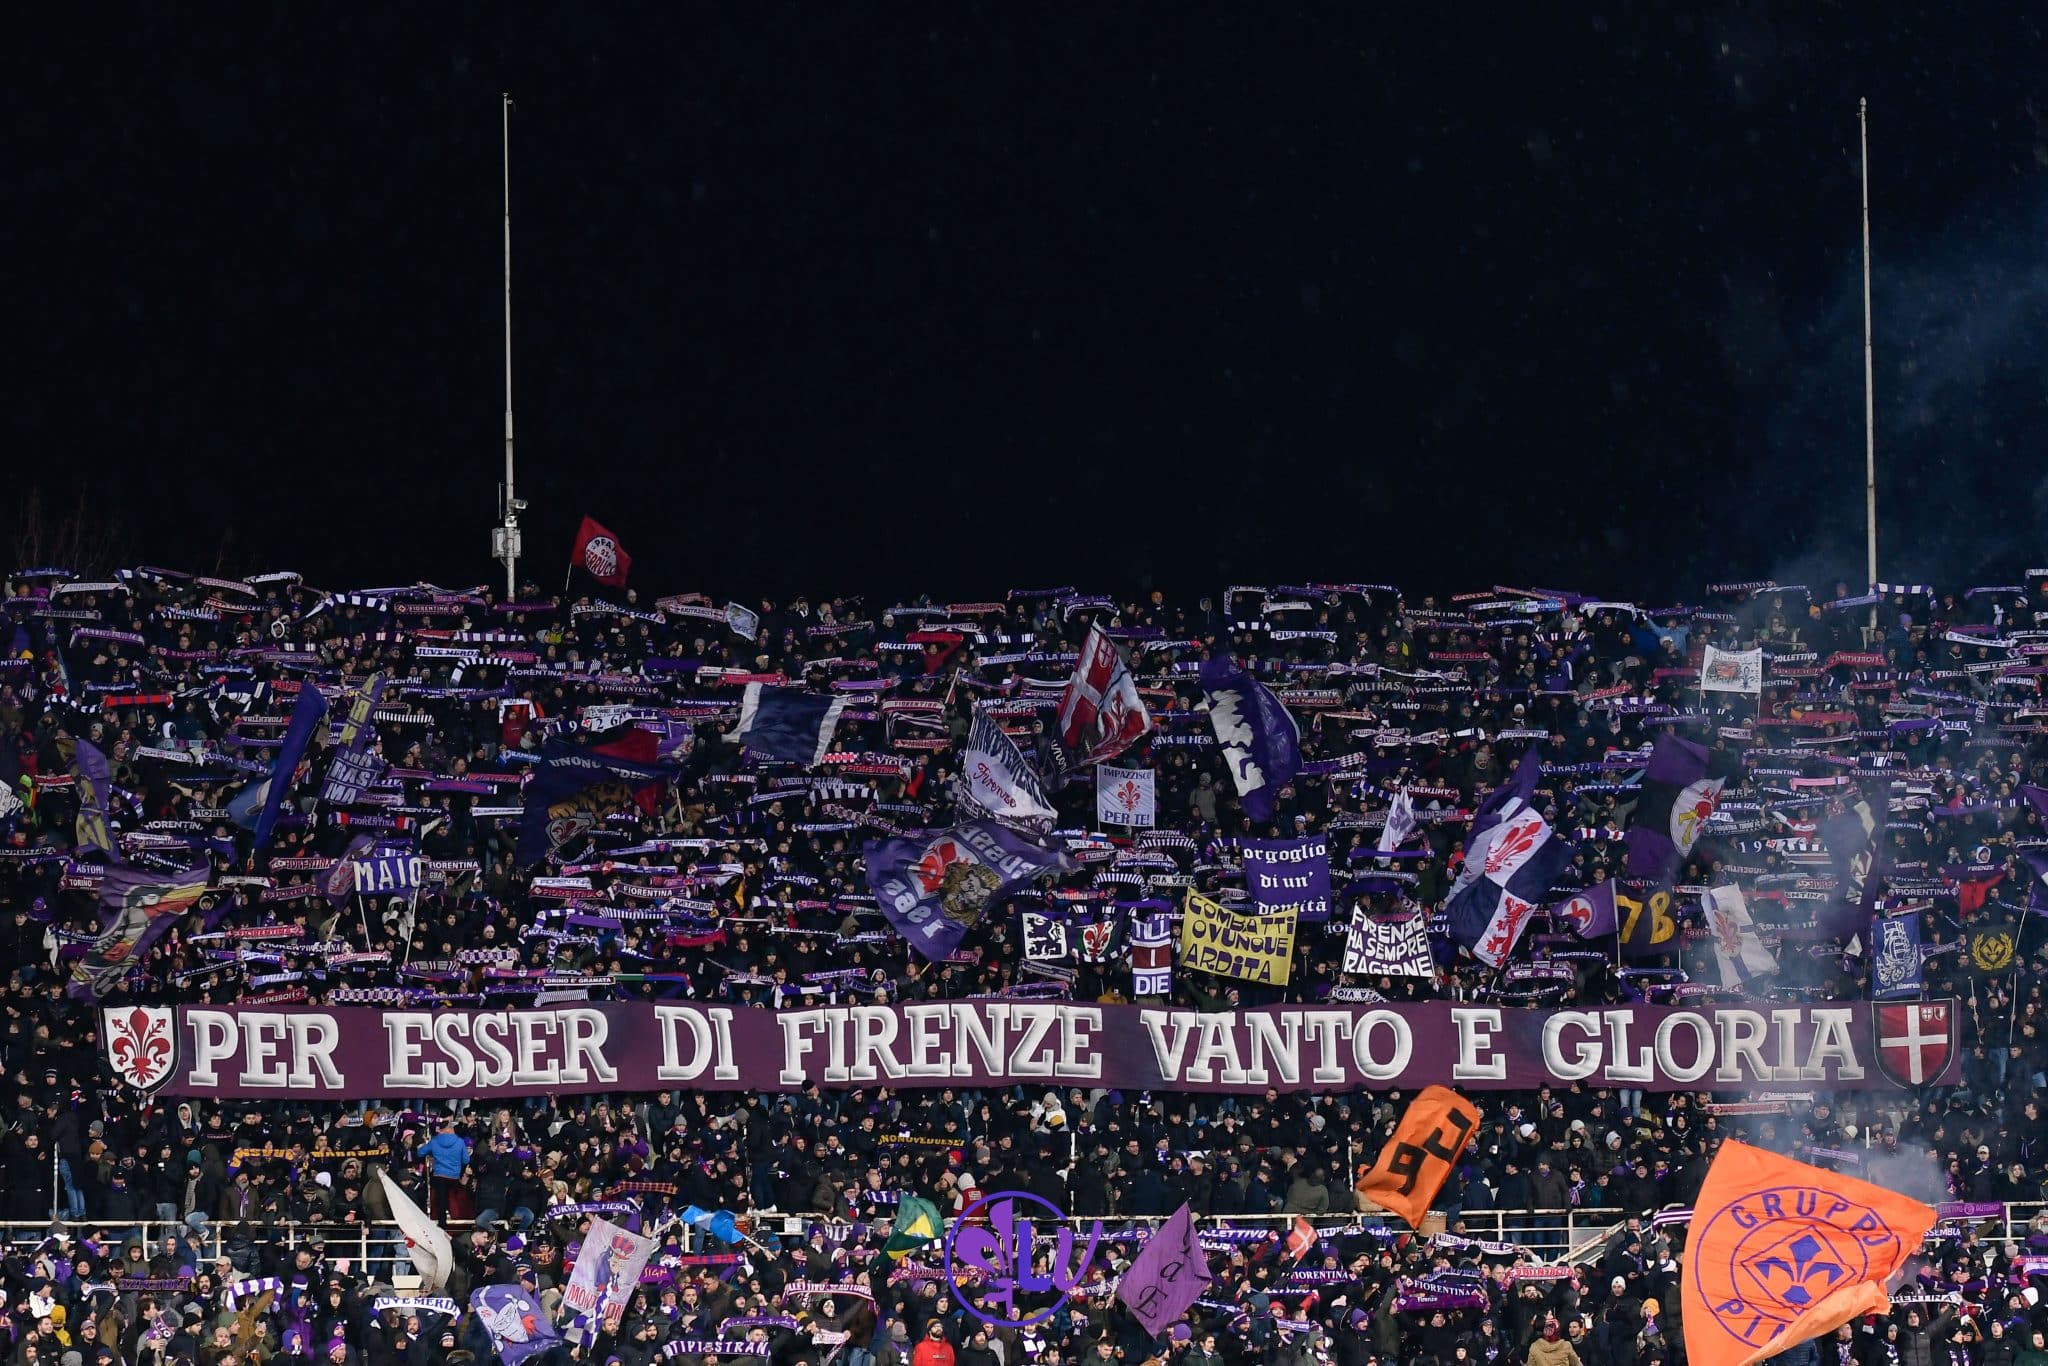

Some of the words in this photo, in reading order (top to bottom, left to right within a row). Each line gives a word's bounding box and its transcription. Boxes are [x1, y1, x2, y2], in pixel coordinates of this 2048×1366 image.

[879, 642, 923, 650] COLLETTIVO
[1060, 652, 1080, 661] MER
[1774, 653, 1817, 661] COLLETTIVO
[508, 668, 562, 677] FIORENTINA
[604, 685, 651, 693] FIORENTINA
[1355, 681, 1401, 692] ULTRAS
[1754, 768, 1800, 776] FIORENTINA
[974, 762, 1017, 808] Firenze
[350, 818, 395, 828] FIORENTINA
[1105, 810, 1130, 824] PER
[1135, 811, 1150, 825] TE!
[1244, 844, 1326, 863] orgoglio
[429, 861, 479, 869] FIORENTINA
[70, 879, 93, 887] TORINO
[1260, 872, 1278, 888] di
[1282, 871, 1315, 888] un'
[623, 885, 673, 898] FIORENTINA
[1894, 888, 1950, 896] FIORENTINA
[1254, 902, 1327, 915] dentità
[1132, 918, 1170, 940] TILL
[1351, 905, 1423, 940] FIRENZE
[1192, 920, 1288, 957] OVUNQUE
[1349, 929, 1362, 951] HA
[1367, 931, 1427, 960] SEMPRE
[1136, 975, 1169, 994] DIE
[187, 1009, 345, 1090] PER
[382, 1010, 619, 1090] ESSER
[654, 1005, 738, 1082] DI
[776, 1003, 1103, 1086] FIRENZE
[1139, 1008, 1413, 1086] VANTO
[1450, 1007, 1507, 1081] E
[1541, 1008, 1865, 1083] GLORIA
[644, 1267, 668, 1278] SIGN
[1291, 1270, 1348, 1281] FIORENTINA
[1414, 1279, 1472, 1296] FIORENTINA
[374, 1297, 411, 1310] JUVE
